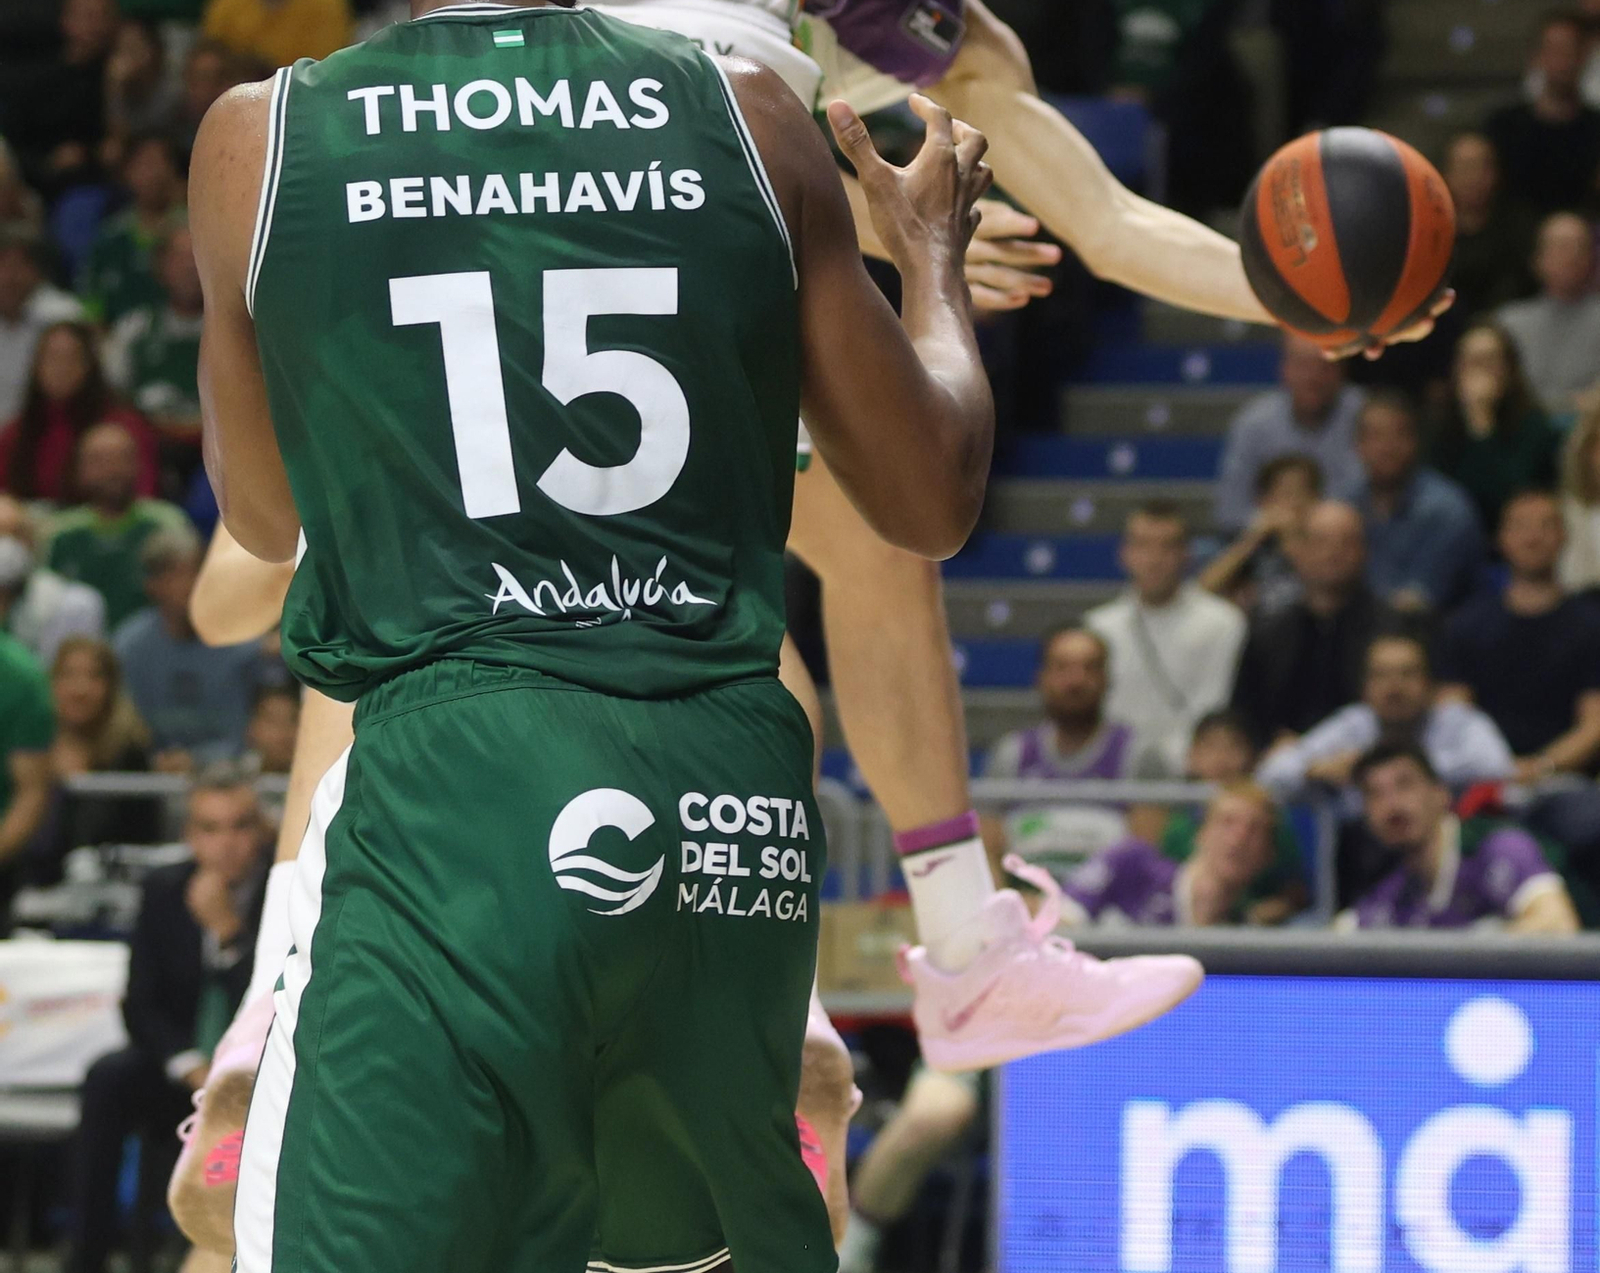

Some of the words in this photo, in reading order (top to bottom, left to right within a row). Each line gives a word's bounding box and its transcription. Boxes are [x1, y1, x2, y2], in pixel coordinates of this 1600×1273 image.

[347, 76, 670, 136] THOMAS
[345, 160, 706, 223] BENAHAVÍS
[388, 267, 692, 520] 15
[678, 791, 810, 841] COSTA
[681, 840, 751, 877] DEL
[759, 846, 812, 884] SOL
[676, 877, 808, 923] MÁLAGA
